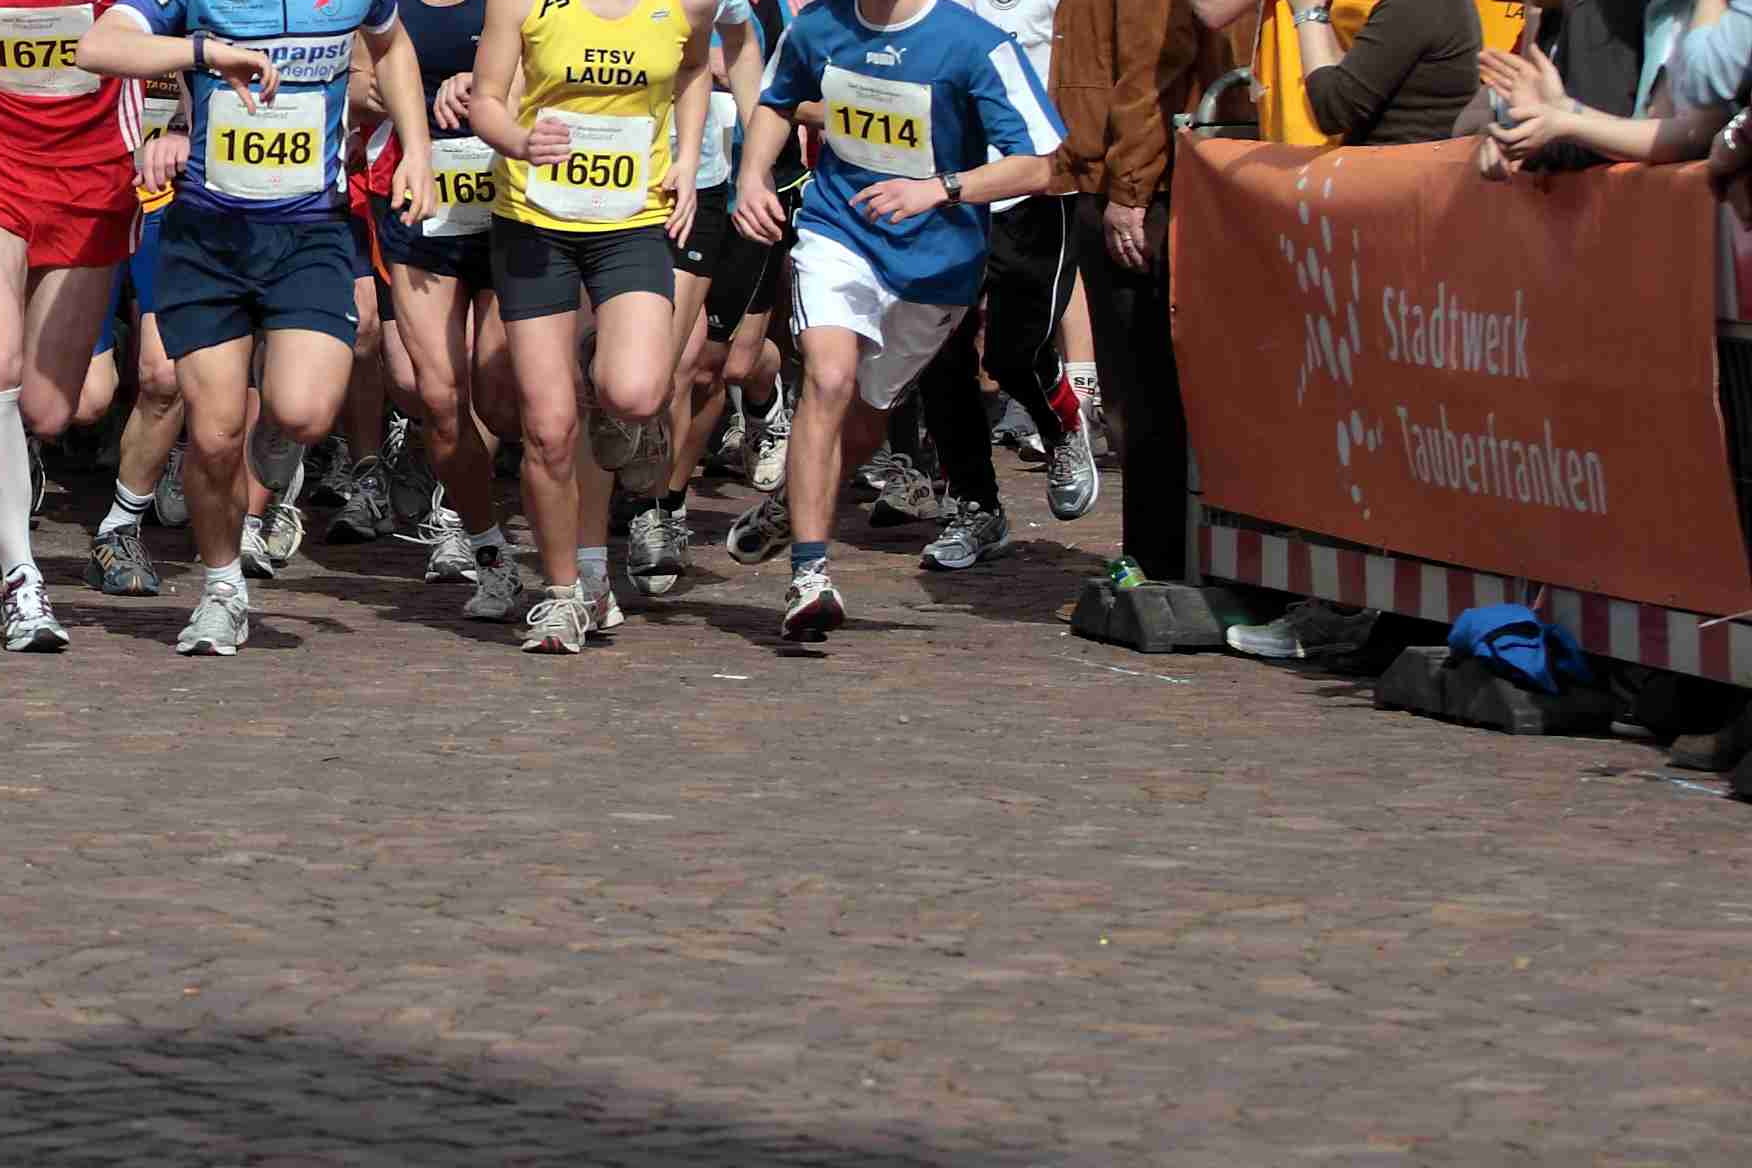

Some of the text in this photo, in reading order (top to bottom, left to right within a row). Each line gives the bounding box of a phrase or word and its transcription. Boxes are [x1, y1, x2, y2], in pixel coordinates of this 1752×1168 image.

[583, 48, 636, 65] ETSV
[565, 66, 648, 87] LAUDA
[836, 106, 918, 148] 1714
[220, 129, 311, 165] 1648
[549, 152, 635, 188] 1650
[1383, 280, 1529, 379] Stadtwerk
[1396, 402, 1608, 515] Tauberfranken
